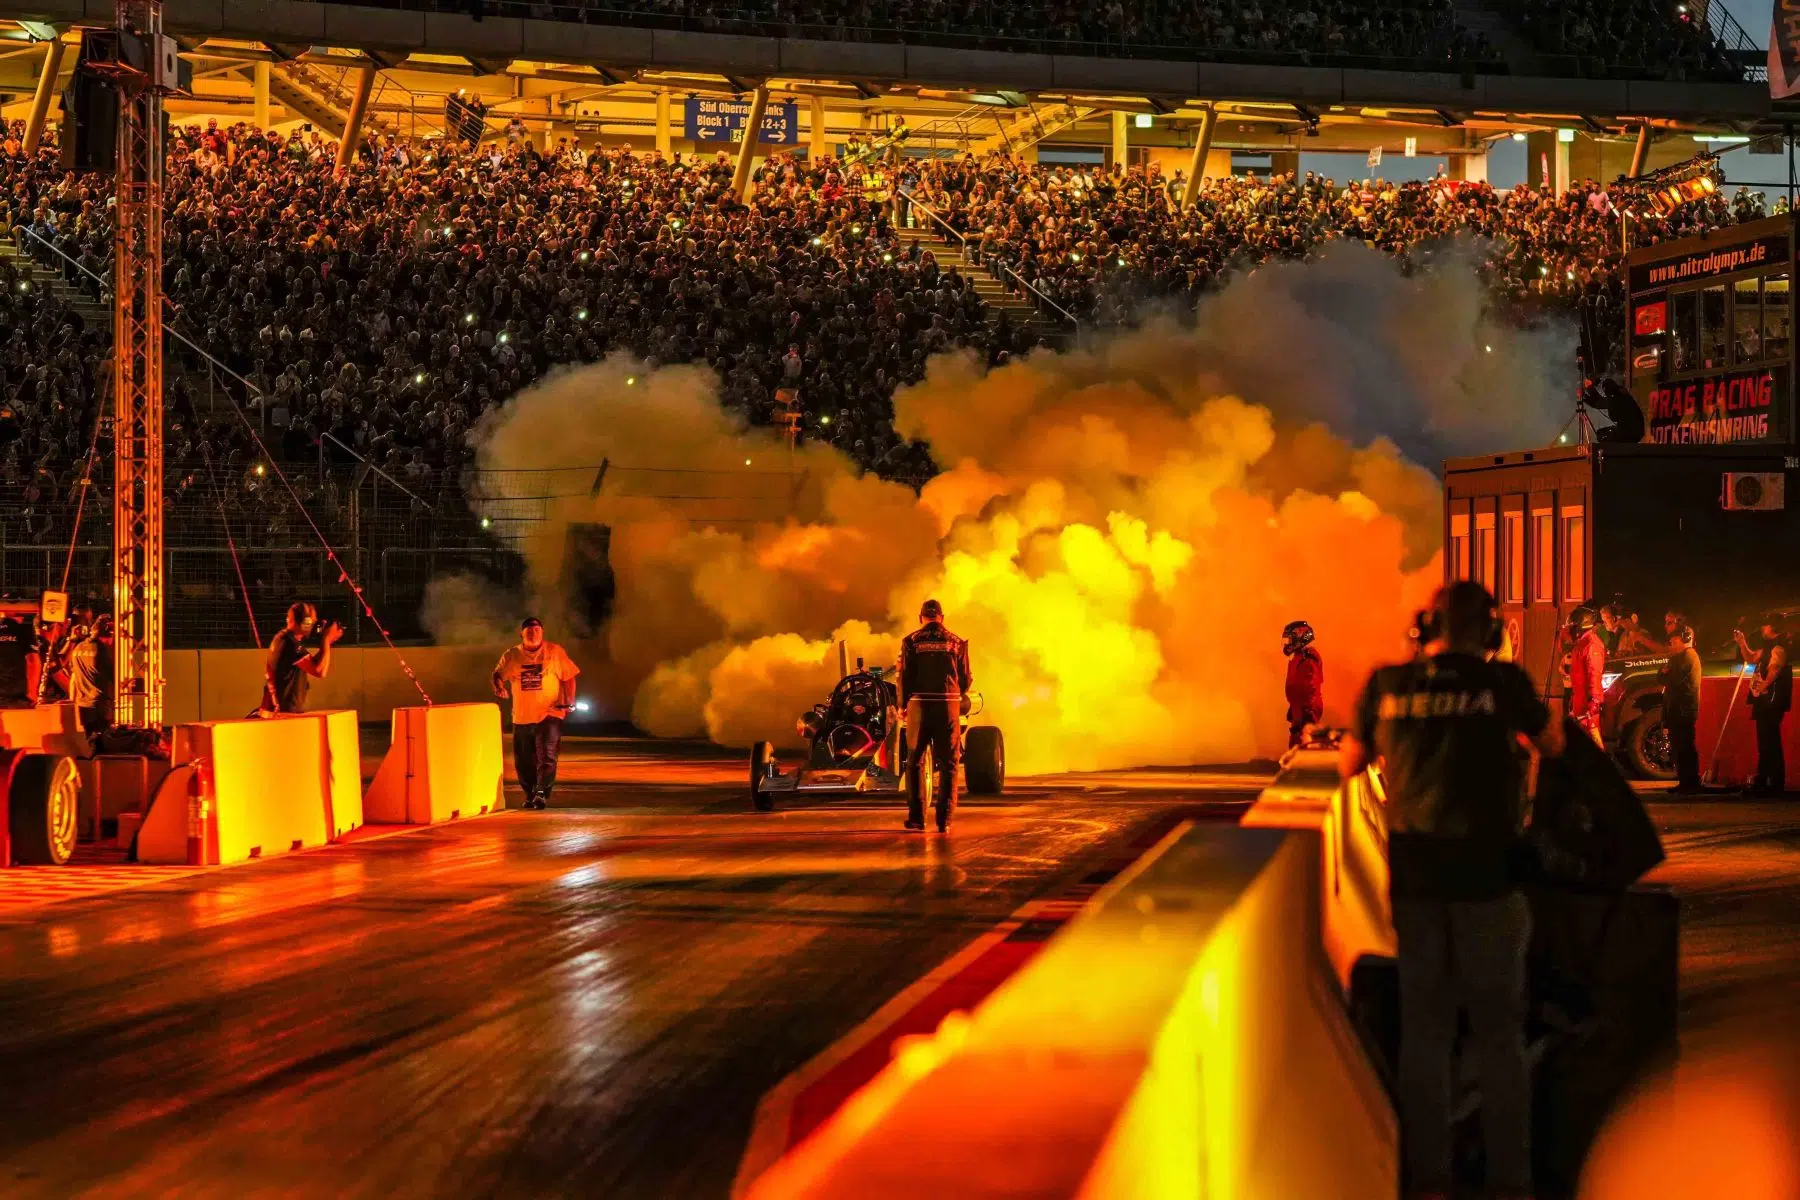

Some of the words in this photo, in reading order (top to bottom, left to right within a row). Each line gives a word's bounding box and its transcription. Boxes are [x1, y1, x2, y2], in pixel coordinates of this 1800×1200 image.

[700, 101, 716, 113] Süd
[719, 102, 752, 115] Oberran
[763, 104, 784, 116] inks
[697, 115, 722, 127] Block
[725, 116, 730, 127] 1
[766, 119, 787, 130] 2+3
[1649, 243, 1766, 283] www.nitrolympx.de
[1703, 375, 1772, 414] RACING
